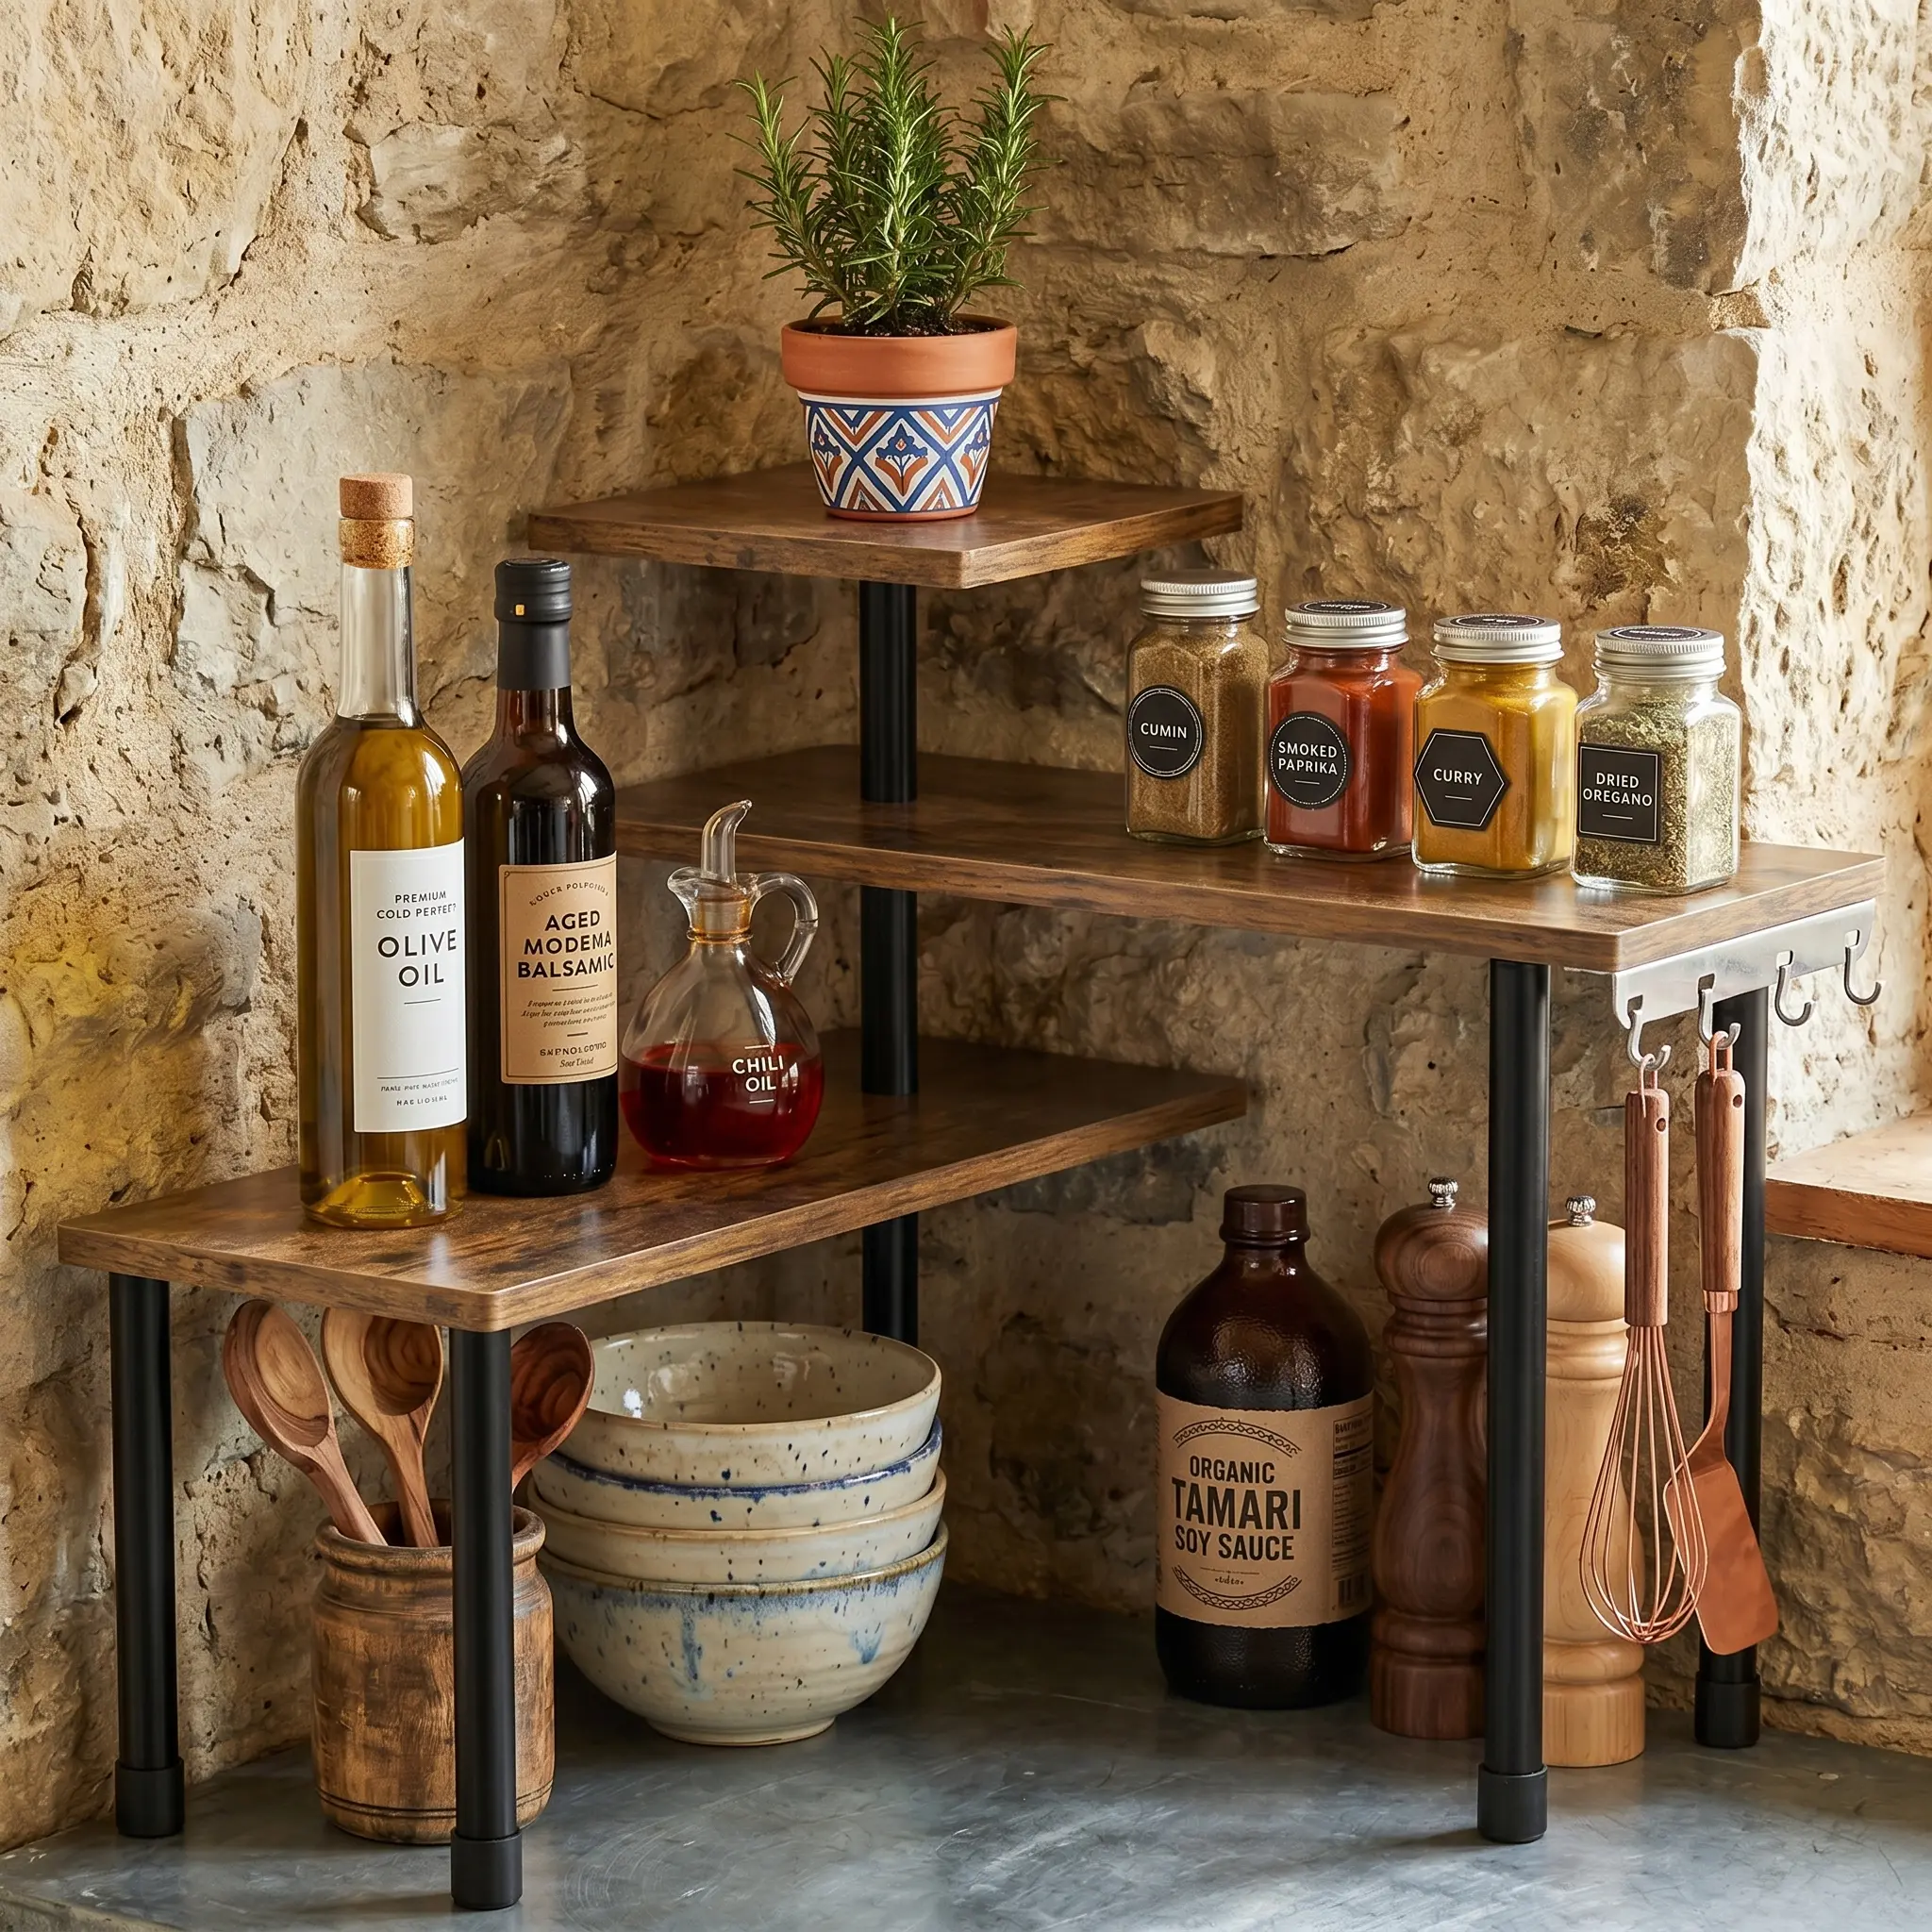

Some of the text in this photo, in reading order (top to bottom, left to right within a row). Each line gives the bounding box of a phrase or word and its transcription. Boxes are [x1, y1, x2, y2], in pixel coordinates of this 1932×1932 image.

[1140, 722, 1188, 740] CUMIN
[1277, 741, 1338, 758] SMOKED
[1277, 758, 1339, 775] PAPRIKA
[1433, 768, 1483, 786] CURRY
[1595, 773, 1640, 789] DRIED
[1582, 788, 1653, 807] OREGANO
[394, 891, 447, 904] PREMIUM
[376, 908, 411, 920] COLD
[544, 909, 601, 932] AGED
[377, 928, 458, 958] OLIVE
[524, 930, 612, 956] MODEMA
[398, 962, 444, 988] OIL
[518, 952, 615, 979] BALSAMIC
[732, 1055, 784, 1074] CHILI
[745, 1075, 776, 1092] OIL
[1189, 1455, 1275, 1484] ORGANIC
[1171, 1476, 1301, 1530] TAMARI
[1174, 1524, 1211, 1557] SOY
[1218, 1533, 1295, 1561] SAUCE
